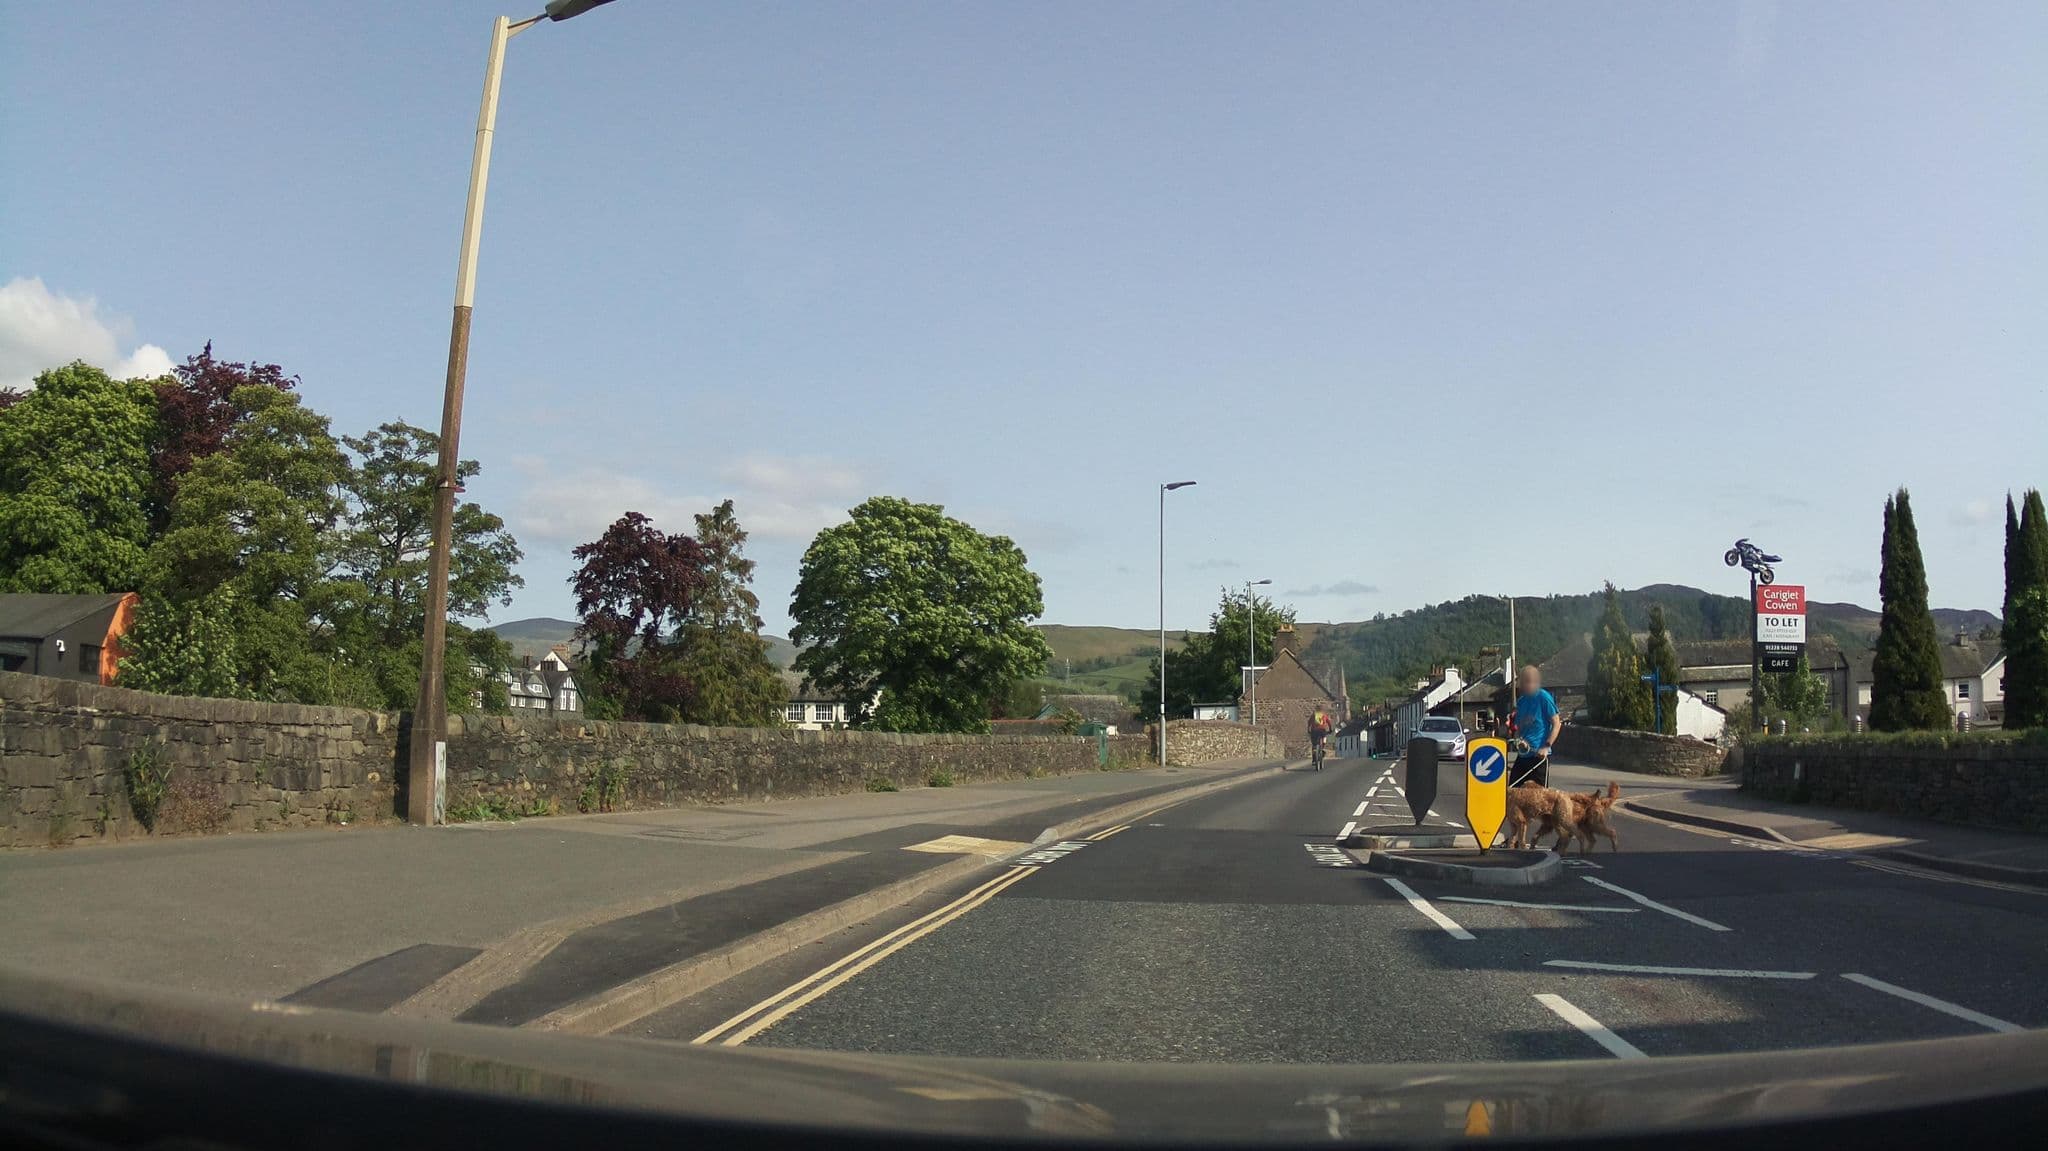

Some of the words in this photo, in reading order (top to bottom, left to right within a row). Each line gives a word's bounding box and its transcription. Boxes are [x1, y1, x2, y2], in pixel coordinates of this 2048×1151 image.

[1766, 600, 1798, 610] Cowen
[1765, 618, 1779, 627] TO
[1782, 618, 1798, 627] LET
